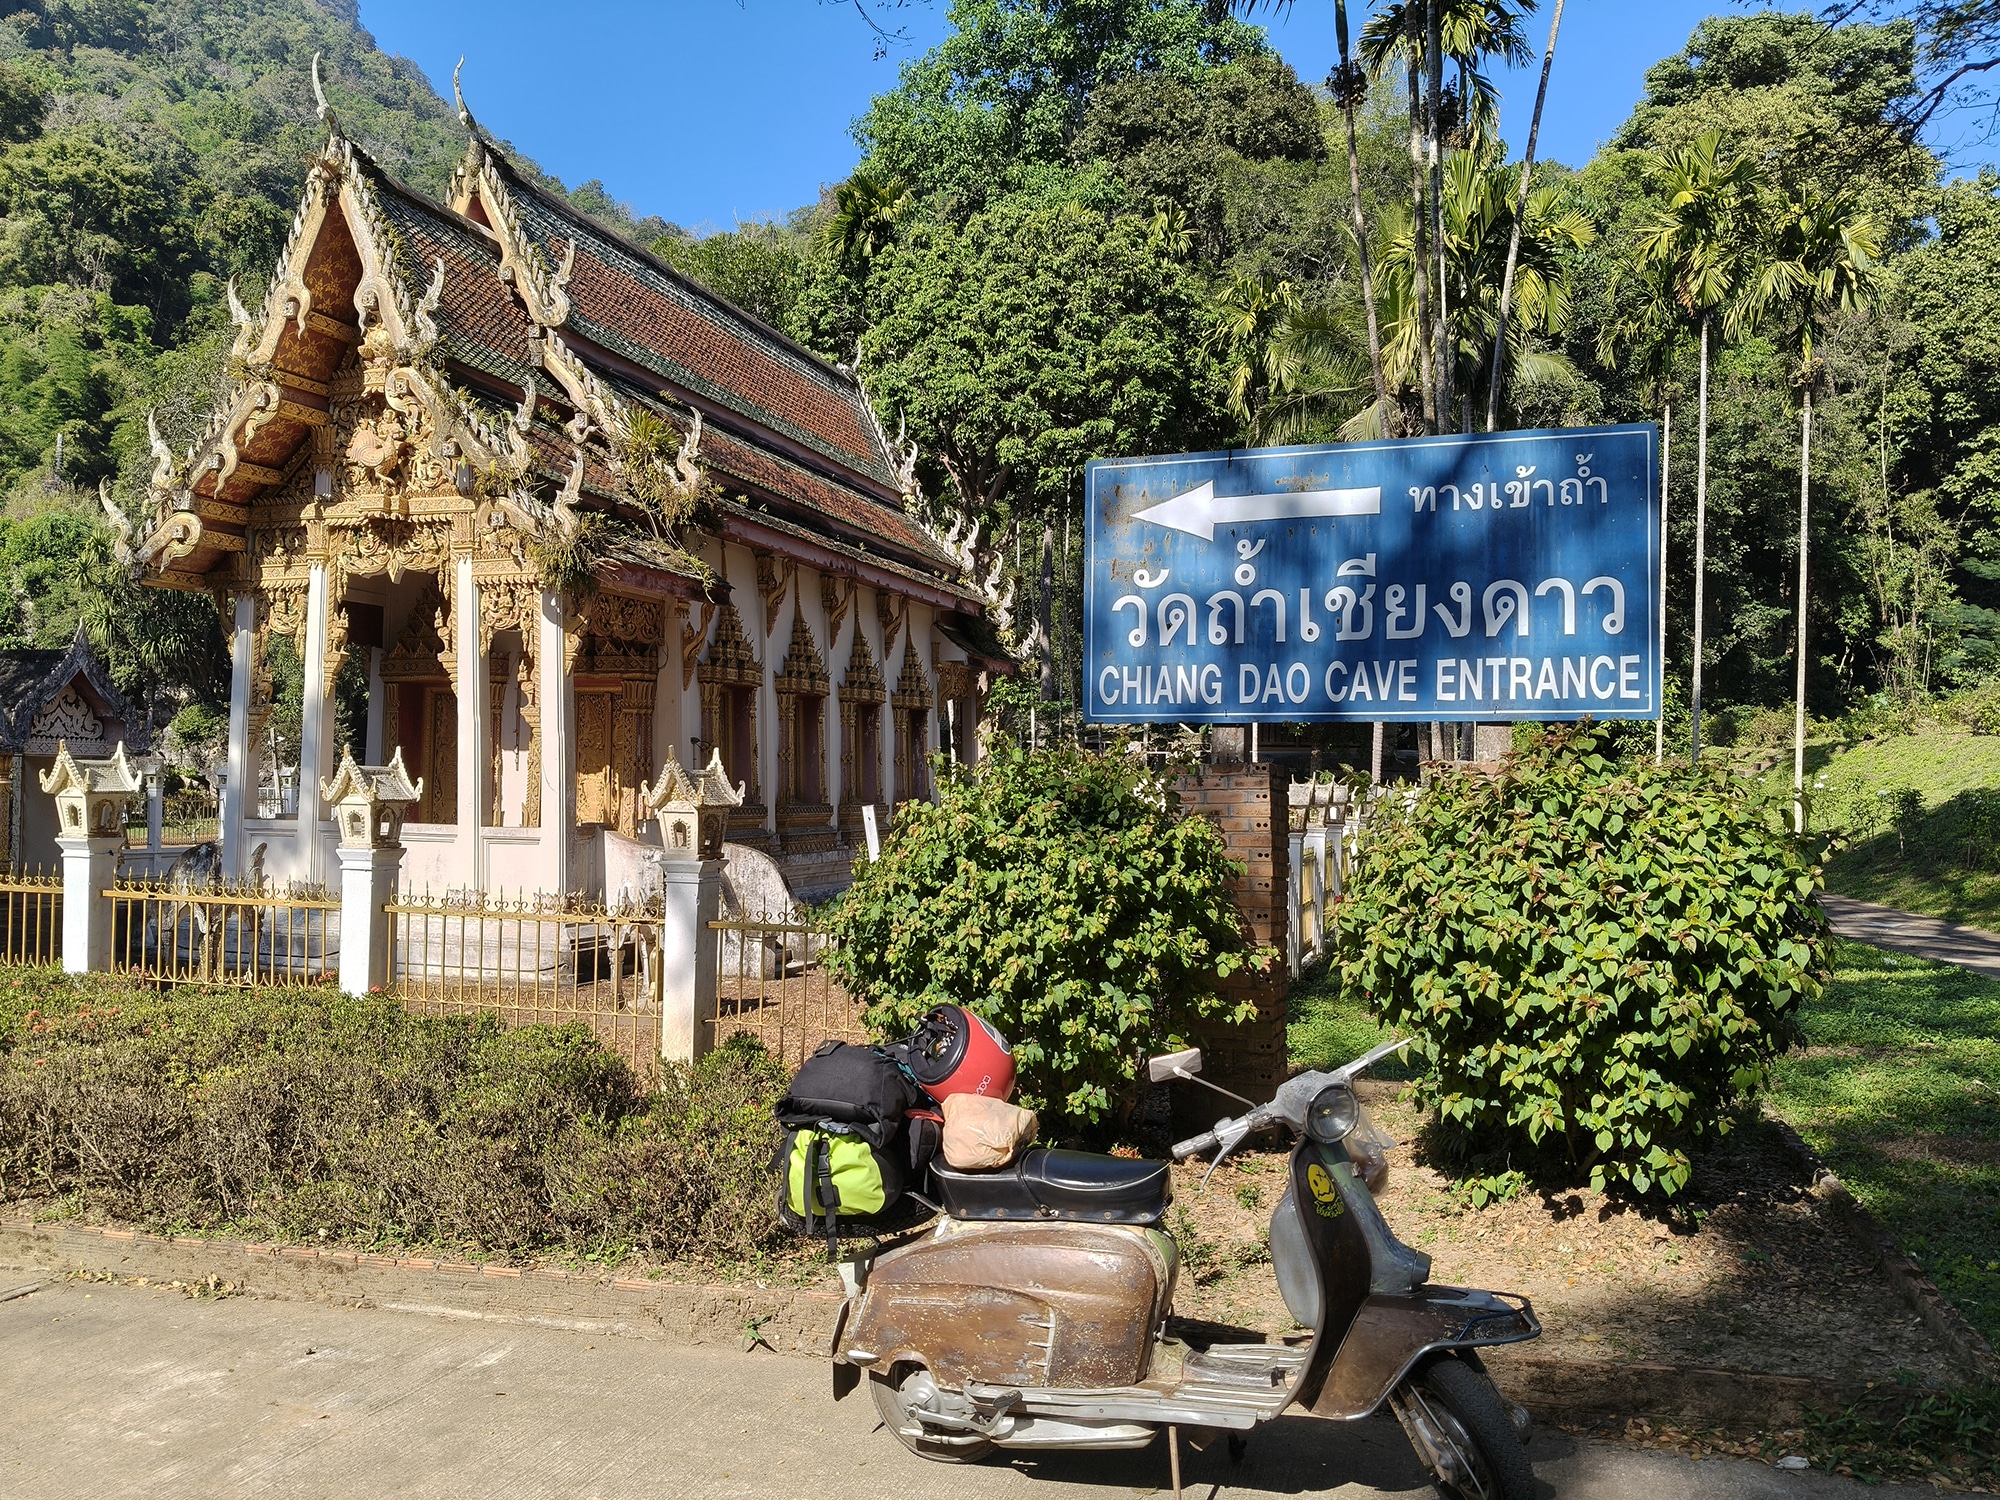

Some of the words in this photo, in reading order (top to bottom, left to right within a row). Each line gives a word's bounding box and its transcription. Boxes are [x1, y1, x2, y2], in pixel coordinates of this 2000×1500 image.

[1408, 453, 1608, 513] ทางเข้าถ้ำ
[1111, 538, 1625, 648] วัดถ้ำเชียงดาว
[1098, 664, 1223, 706] CHIANG
[1238, 661, 1311, 705] DAO
[1324, 659, 1418, 703] CAVE
[1436, 654, 1641, 702] ENTRANCE
